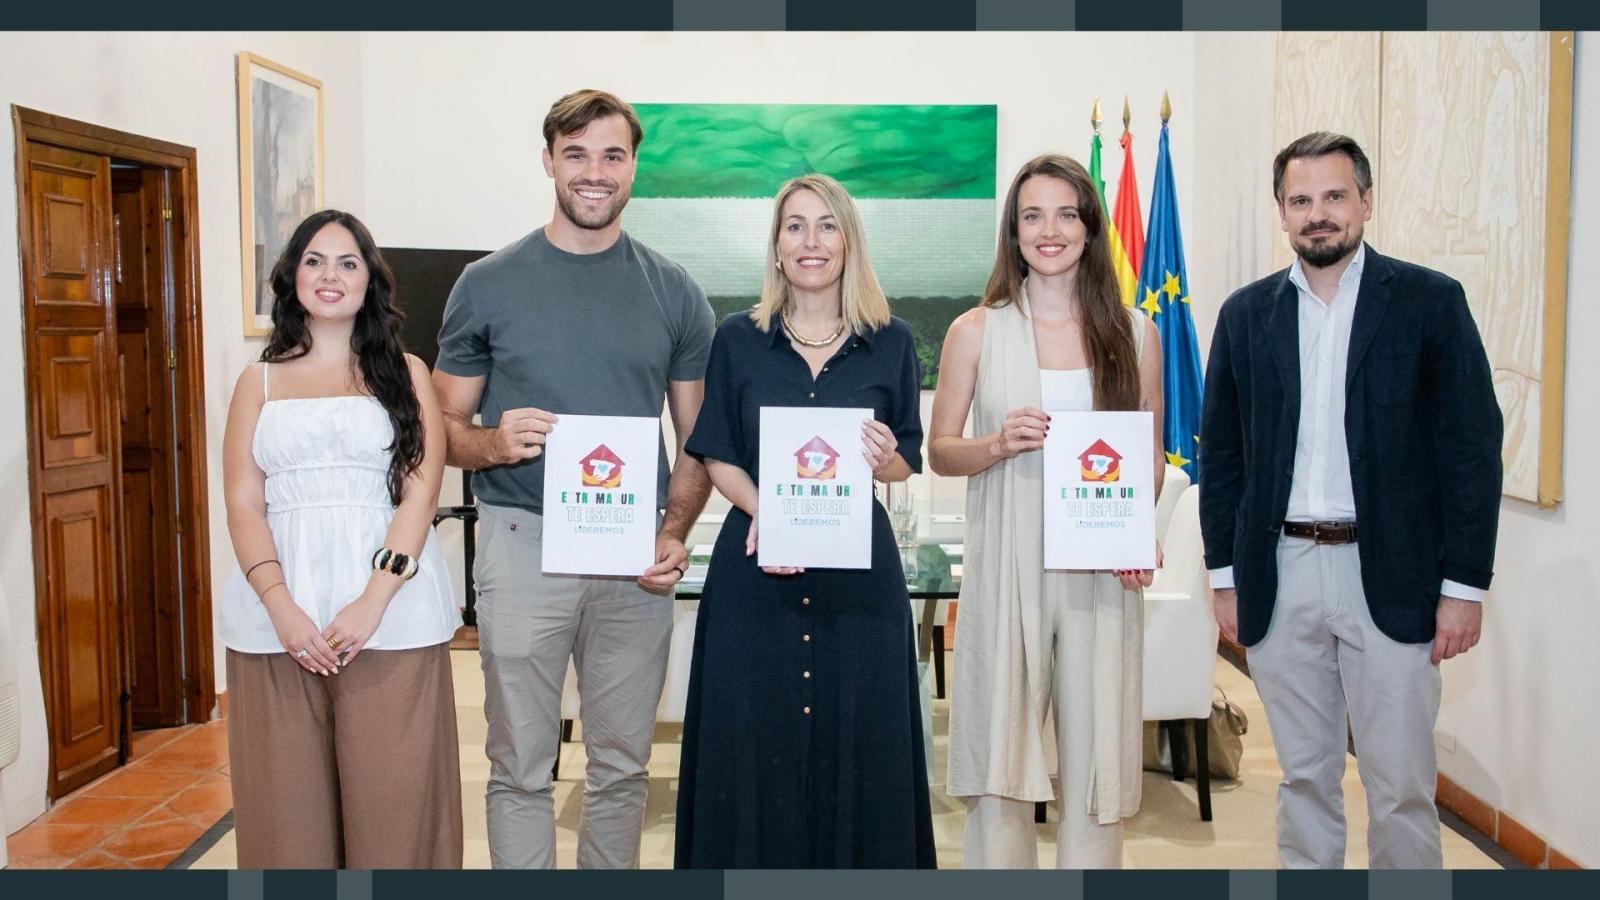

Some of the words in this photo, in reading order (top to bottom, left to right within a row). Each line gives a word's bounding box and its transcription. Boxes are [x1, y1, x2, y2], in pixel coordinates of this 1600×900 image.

[567, 506, 582, 522] TE
[585, 506, 634, 523] ESPERA
[782, 498, 797, 514] TE
[801, 499, 849, 515] ESPERA
[1067, 501, 1082, 517] TE
[1086, 501, 1135, 517] ESPERA
